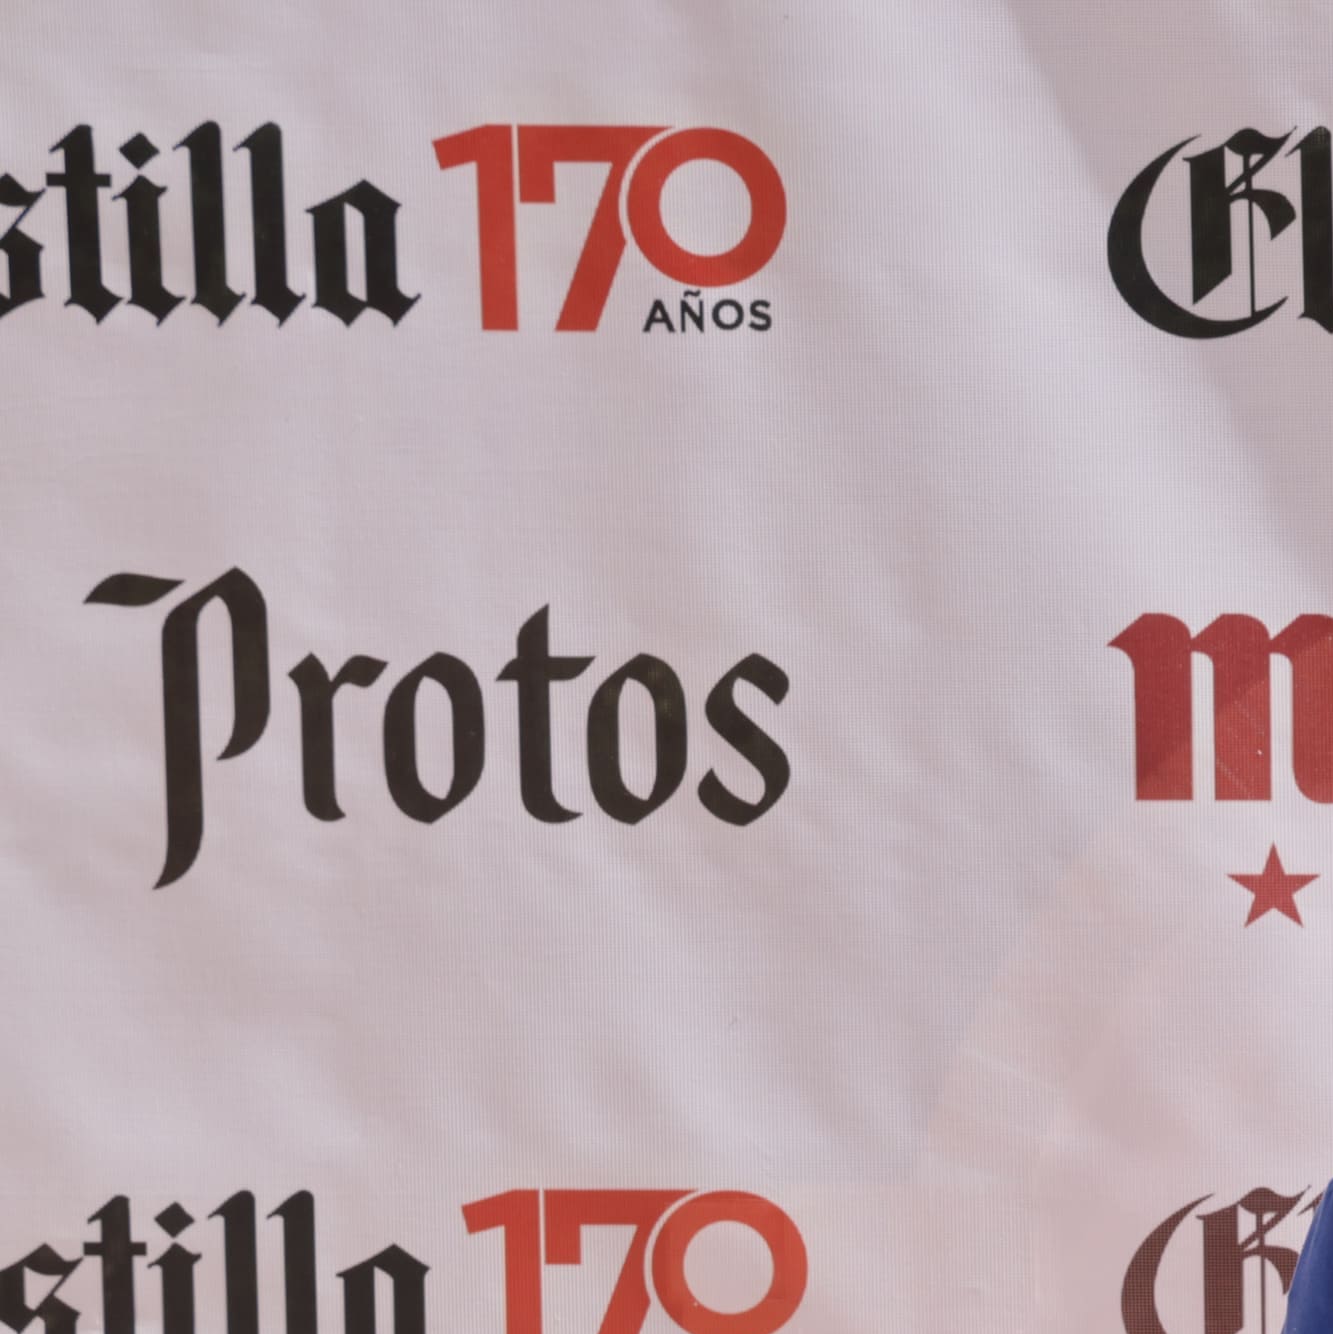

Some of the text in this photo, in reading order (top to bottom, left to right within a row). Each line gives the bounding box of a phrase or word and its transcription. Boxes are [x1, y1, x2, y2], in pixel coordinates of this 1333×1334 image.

[432, 124, 787, 332] 170
[643, 290, 772, 333] AÑOS
[83, 566, 791, 891] Protos
